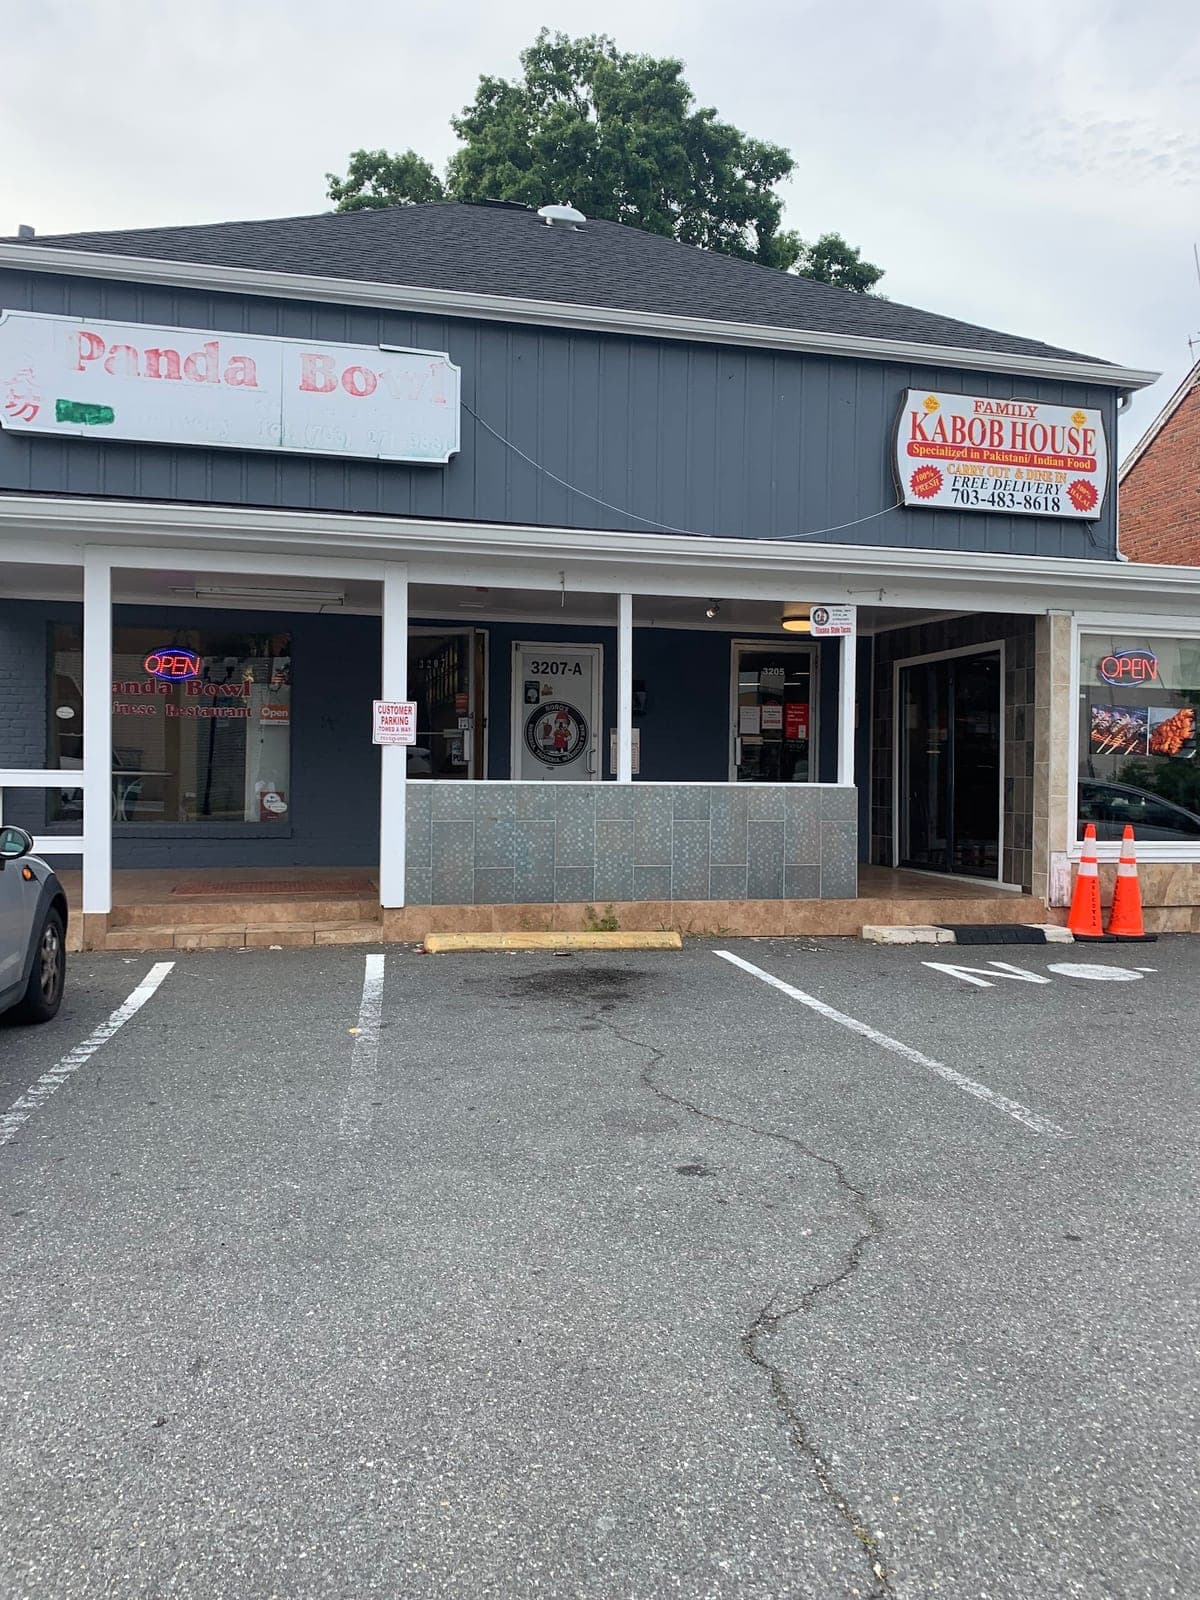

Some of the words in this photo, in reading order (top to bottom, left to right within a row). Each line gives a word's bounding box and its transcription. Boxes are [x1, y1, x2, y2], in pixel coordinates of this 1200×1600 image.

[72, 331, 258, 387] Panda
[974, 400, 1038, 418] FAMILY
[911, 411, 1004, 448] KABOB
[1010, 420, 1097, 457] HOUSE
[912, 443, 968, 458] Specialized
[971, 449, 980, 459] in
[1033, 453, 1064, 467] Indian
[1067, 457, 1091, 469] Food
[915, 469, 934, 483] 100%
[946, 463, 985, 477] CARRY
[987, 465, 1011, 478] OUT
[1015, 470, 1024, 480] &
[1026, 470, 1053, 482] DINE
[1055, 472, 1068, 484] IN
[914, 478, 940, 495] FRESH
[952, 476, 990, 490] FREE
[993, 478, 1063, 496] DELIVERY
[951, 488, 1061, 512] 703-483-8618
[145, 655, 200, 675] OPEN
[530, 660, 583, 676] 3207-A
[762, 667, 785, 676] 3205
[1101, 656, 1158, 680] OPEN
[112, 678, 173, 696] anda
[185, 679, 252, 698] Bowl
[112, 701, 157, 715] inese
[166, 703, 253, 718] Restaurant
[261, 706, 289, 718] Open
[378, 704, 413, 716] CUSTOMER
[381, 715, 409, 726] PARKING
